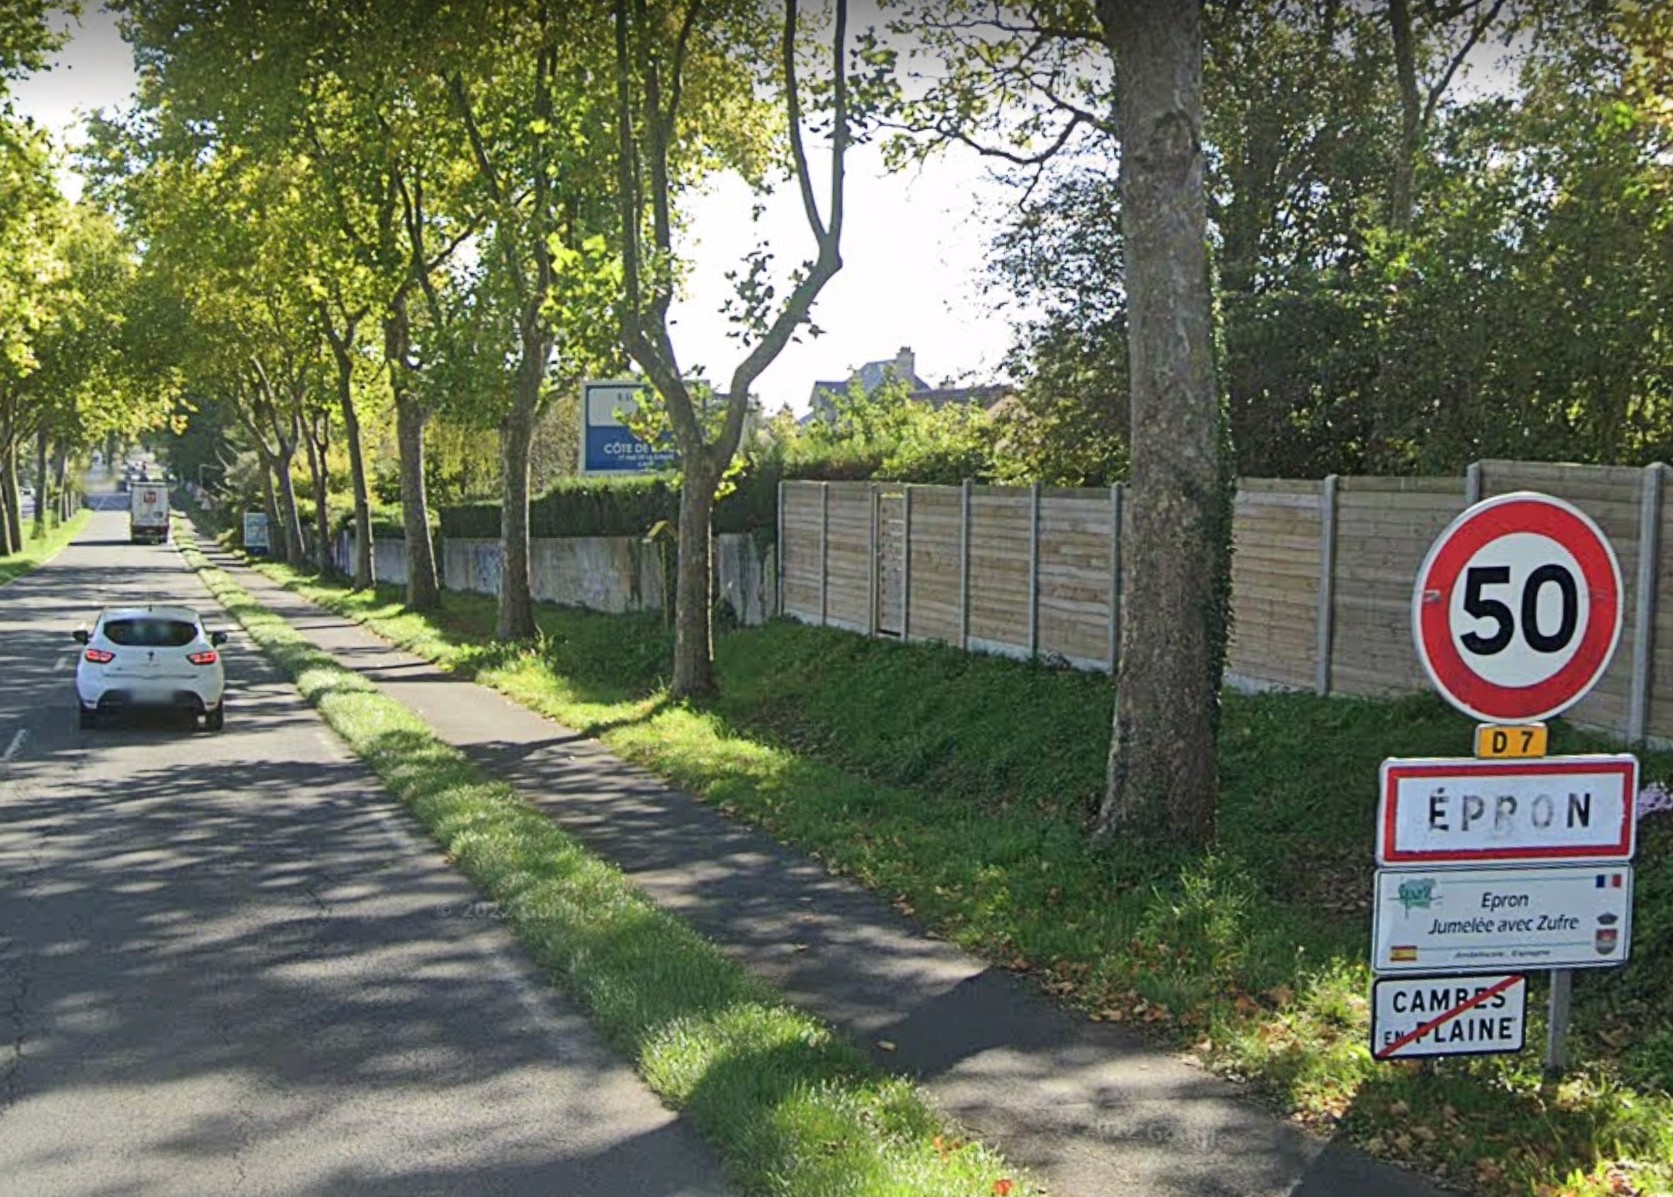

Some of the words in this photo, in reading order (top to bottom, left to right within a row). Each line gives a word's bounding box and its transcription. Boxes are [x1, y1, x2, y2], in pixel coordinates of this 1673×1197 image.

[1460, 563, 1578, 656] 50
[1492, 732, 1507, 754] D
[1521, 731, 1534, 753] 7
[1428, 787, 1591, 832] ÉPRON
[1481, 891, 1529, 912] Epron
[1428, 917, 1495, 935] Jumelée
[1497, 918, 1534, 932] avec
[1536, 914, 1580, 931] Zufre
[1393, 986, 1506, 1013] CAMBES
[1384, 1031, 1405, 1046] EN
[1415, 1017, 1513, 1044] PLAINE
